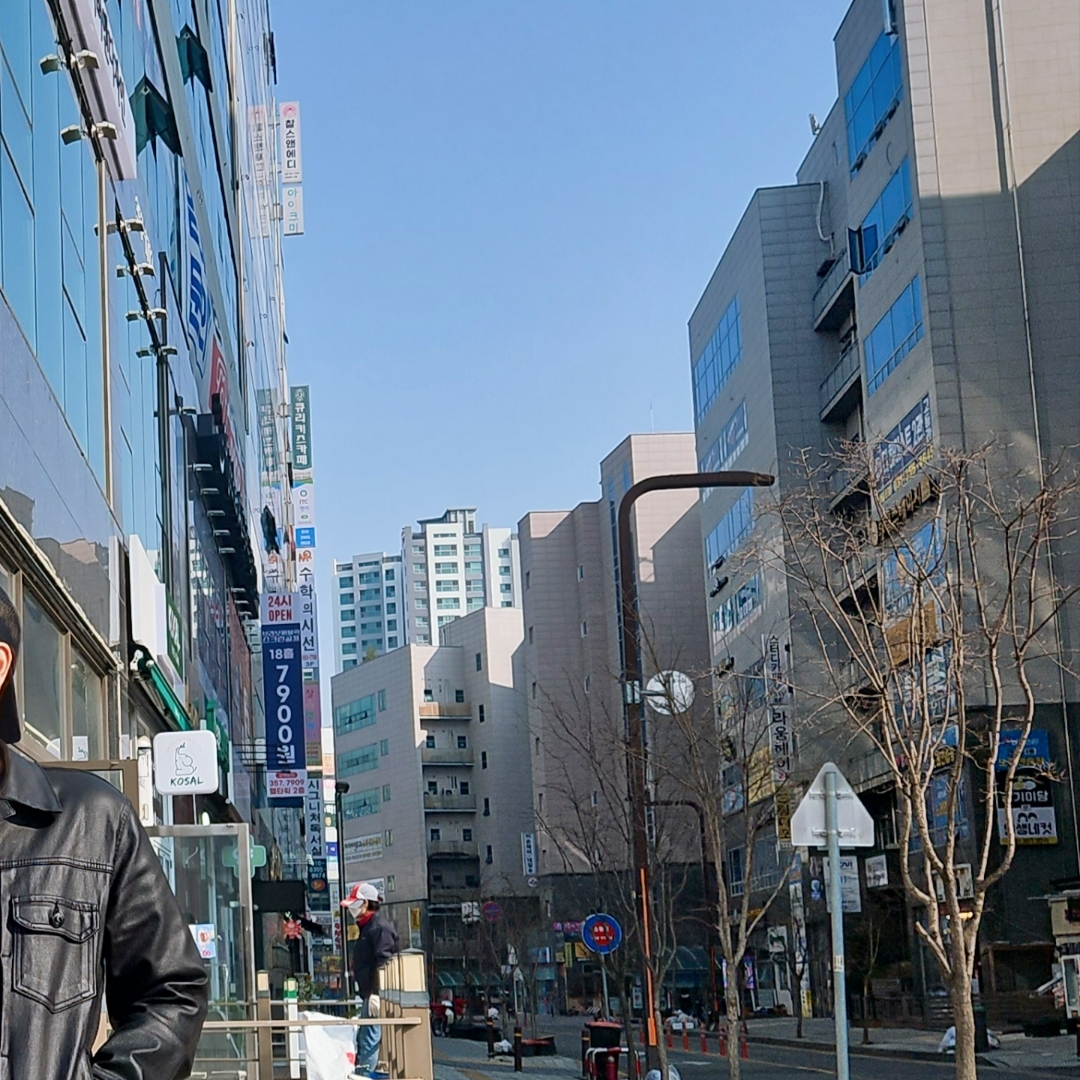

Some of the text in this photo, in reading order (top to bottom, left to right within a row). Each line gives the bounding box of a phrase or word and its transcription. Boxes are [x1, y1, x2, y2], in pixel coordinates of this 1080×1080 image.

[285, 119, 296, 169] 찰스앤에디
[294, 402, 308, 466] 큐리키즈카페
[268, 595, 292, 608] 24시
[268, 609, 292, 622] OPEN
[269, 648, 294, 660] 18홀
[275, 664, 296, 764] 7900원
[773, 710, 790, 771] 라움헤어
[170, 776, 204, 787] KOSAL
[1002, 790, 1049, 802] 기미당
[307, 779, 322, 857] 시그니처독서실
